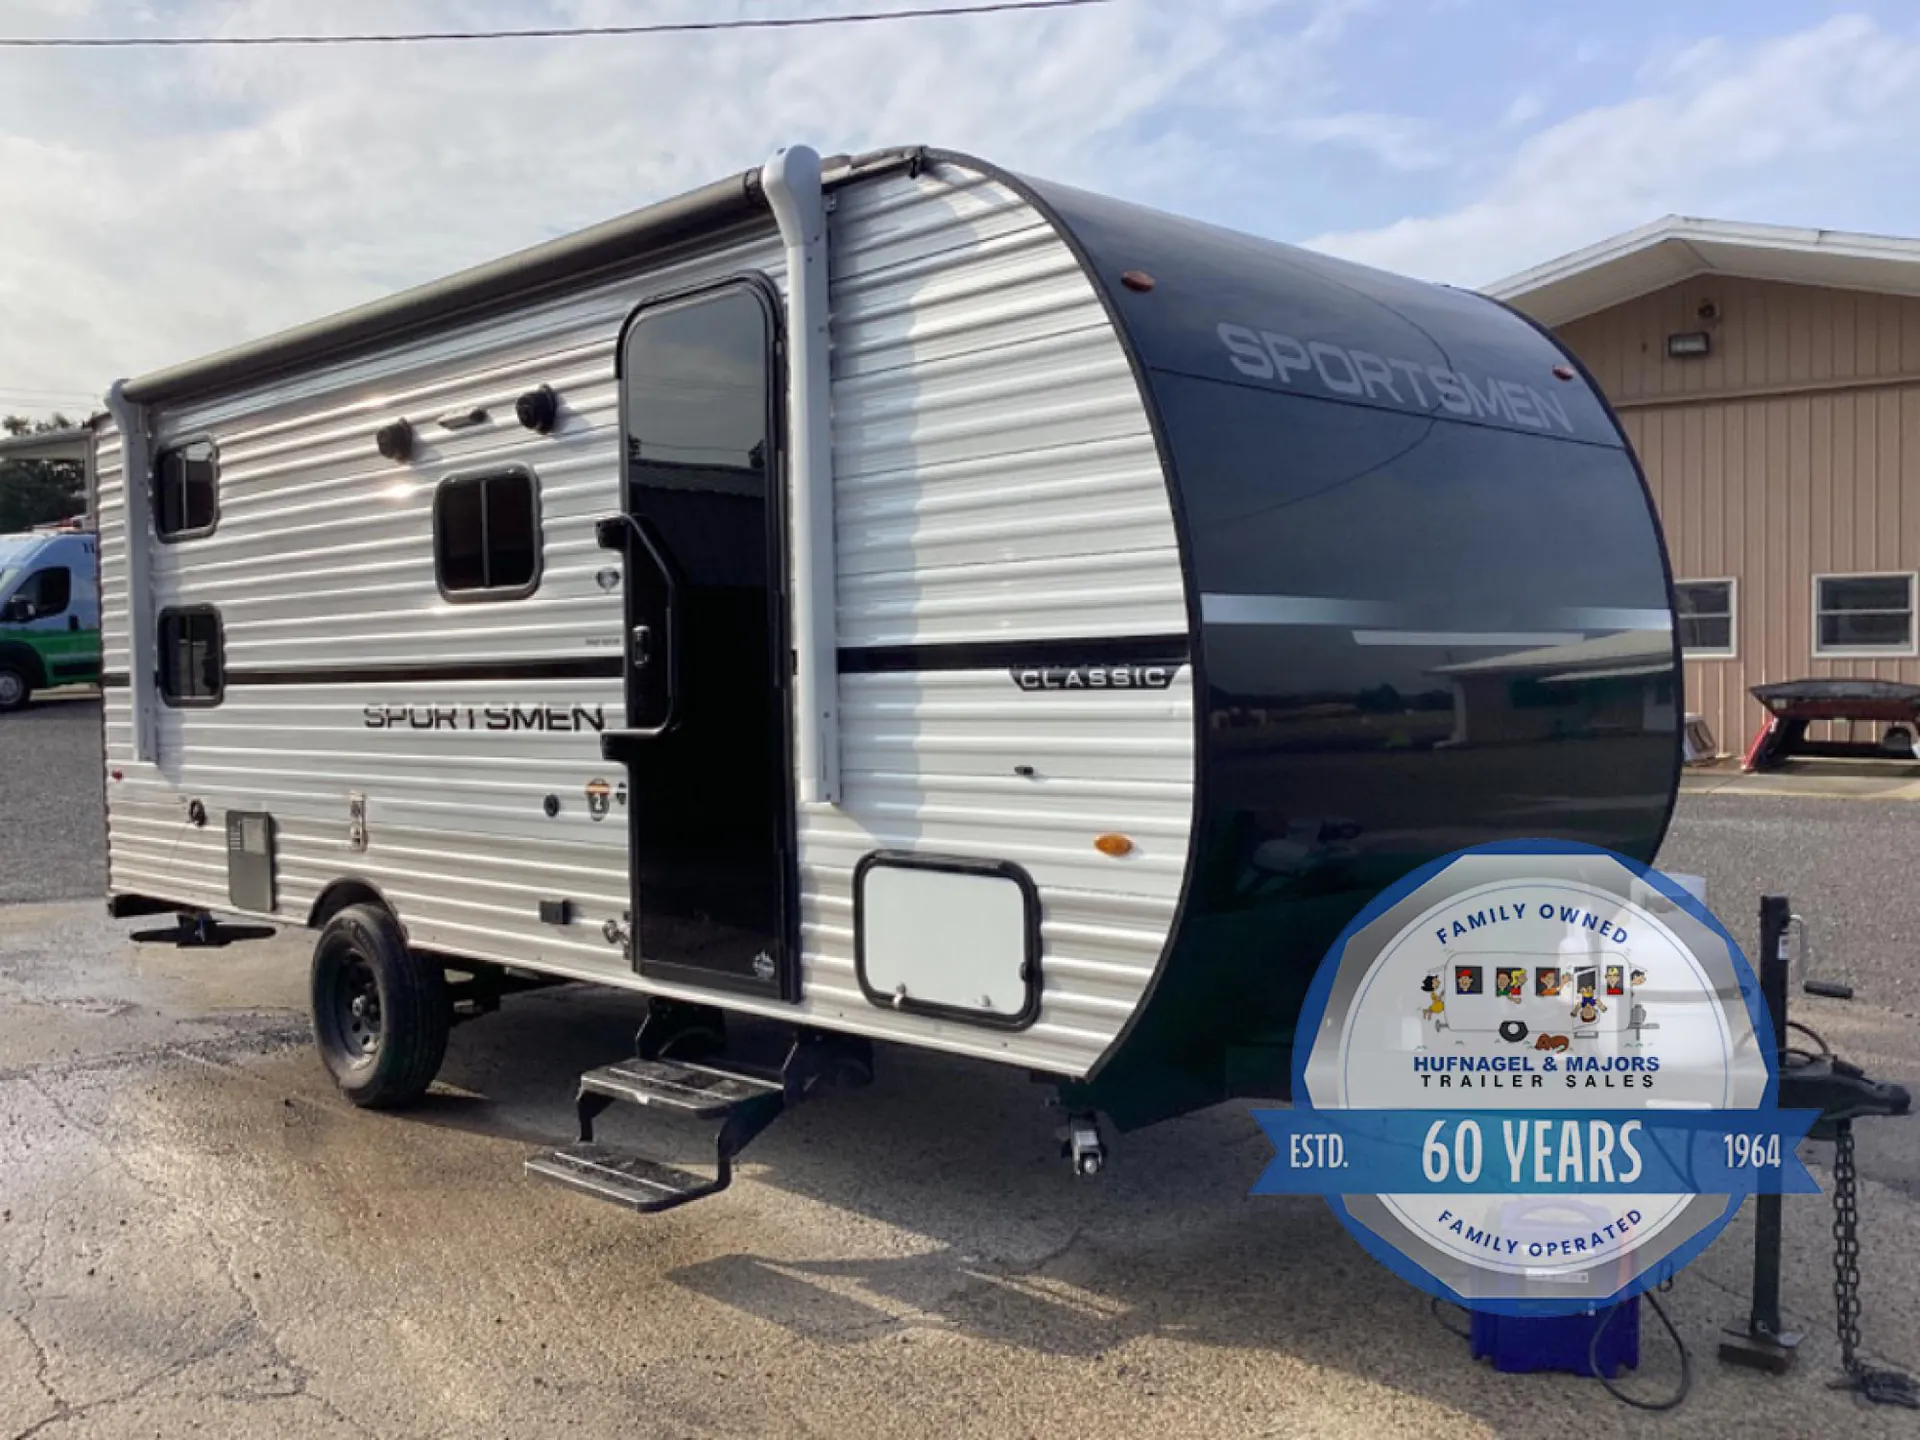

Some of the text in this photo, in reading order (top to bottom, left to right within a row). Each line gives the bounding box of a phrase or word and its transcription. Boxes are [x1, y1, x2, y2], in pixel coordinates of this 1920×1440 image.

[1217, 322, 1574, 433] SPORTSMEN
[1021, 668, 1166, 688] CLASSIC
[363, 702, 605, 731] SPORTSMEN
